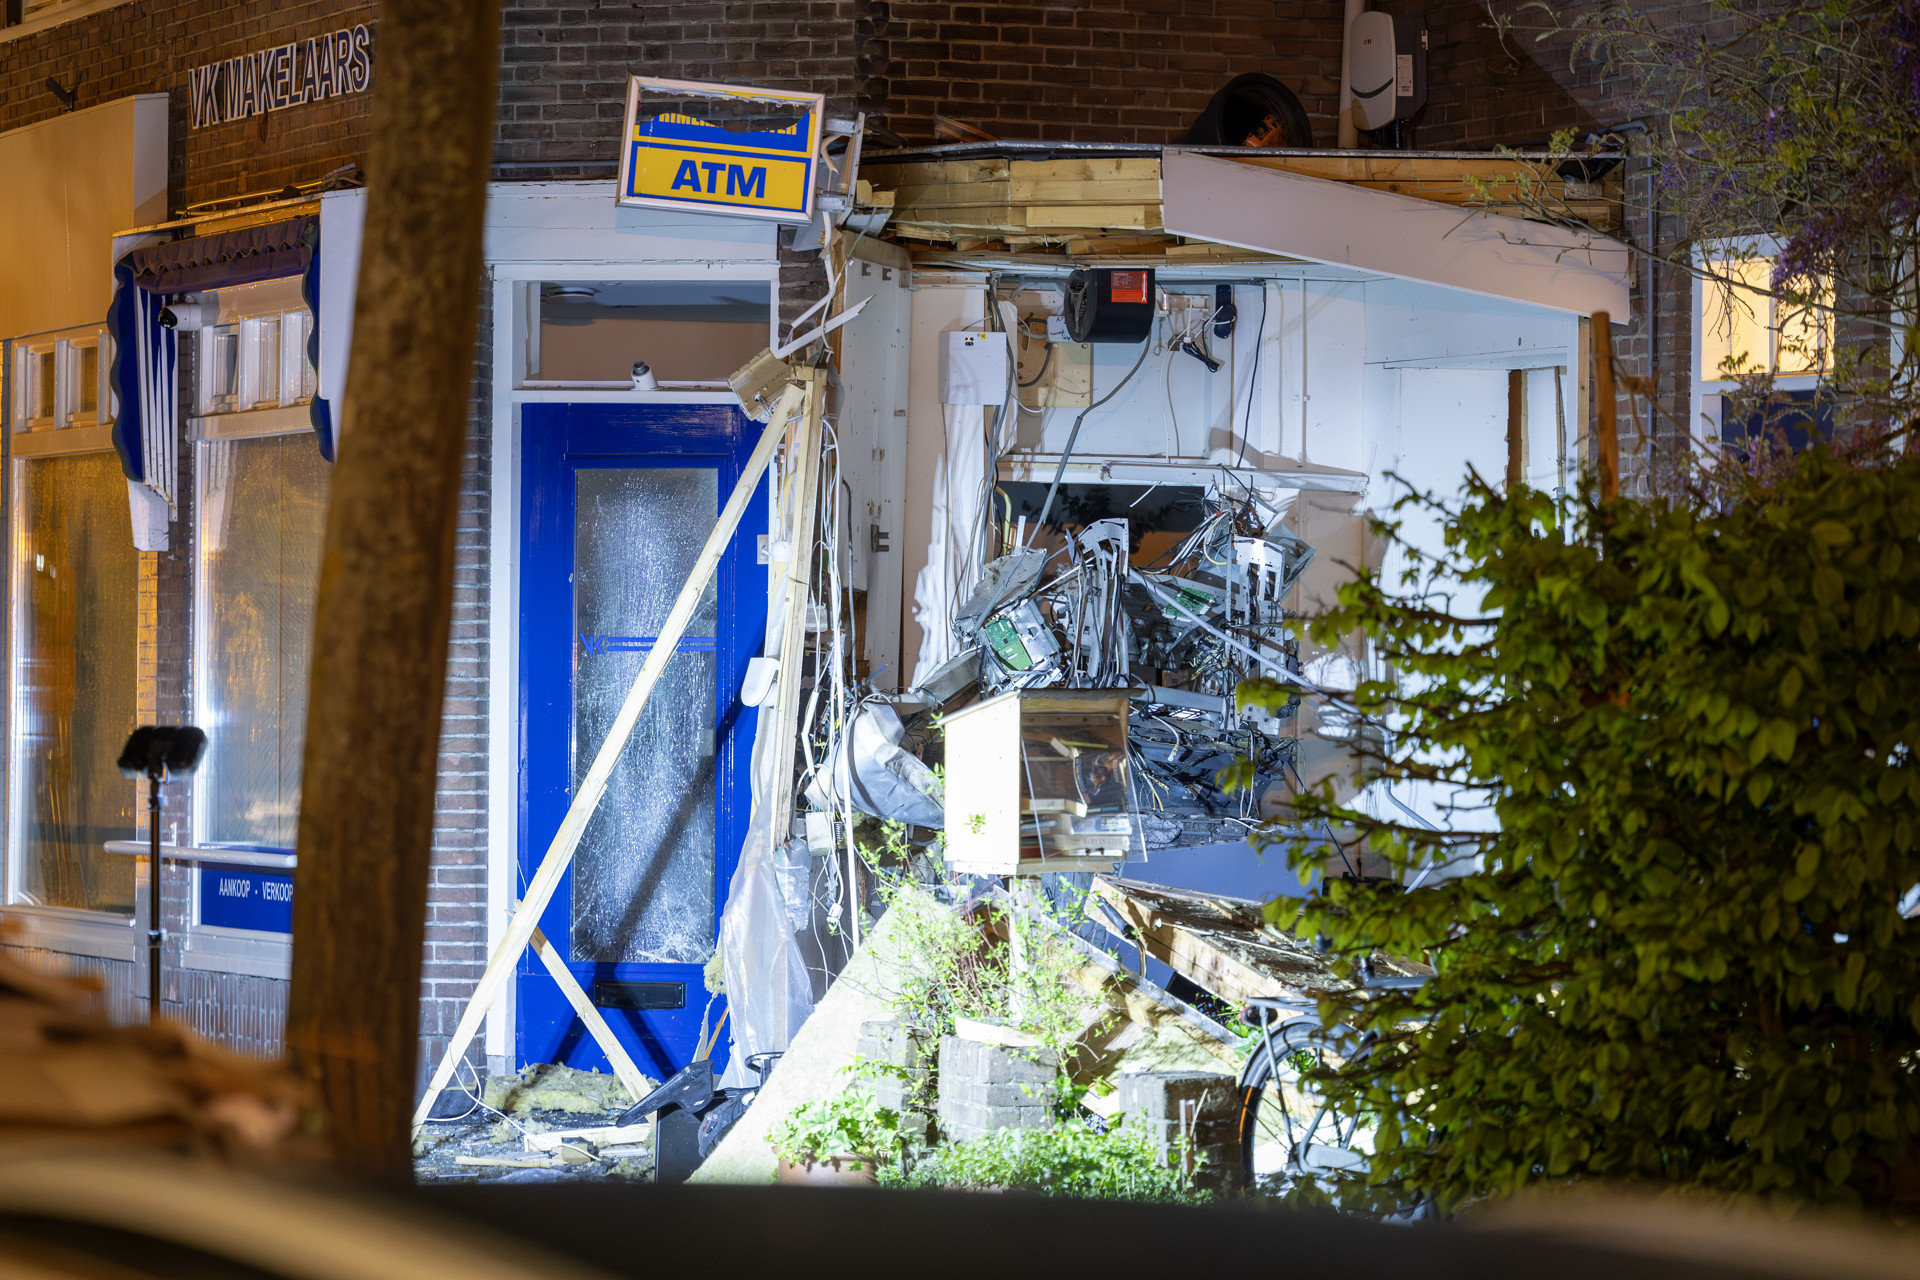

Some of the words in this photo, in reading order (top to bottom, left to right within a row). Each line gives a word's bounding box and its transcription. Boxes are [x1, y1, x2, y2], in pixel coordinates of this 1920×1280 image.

[188, 61, 220, 130] VK
[223, 23, 371, 123] MAKELAARS
[670, 158, 768, 199] ATM
[578, 631, 607, 656] VK
[218, 877, 251, 898] AANKOOP
[261, 881, 294, 902] VERKOOP
